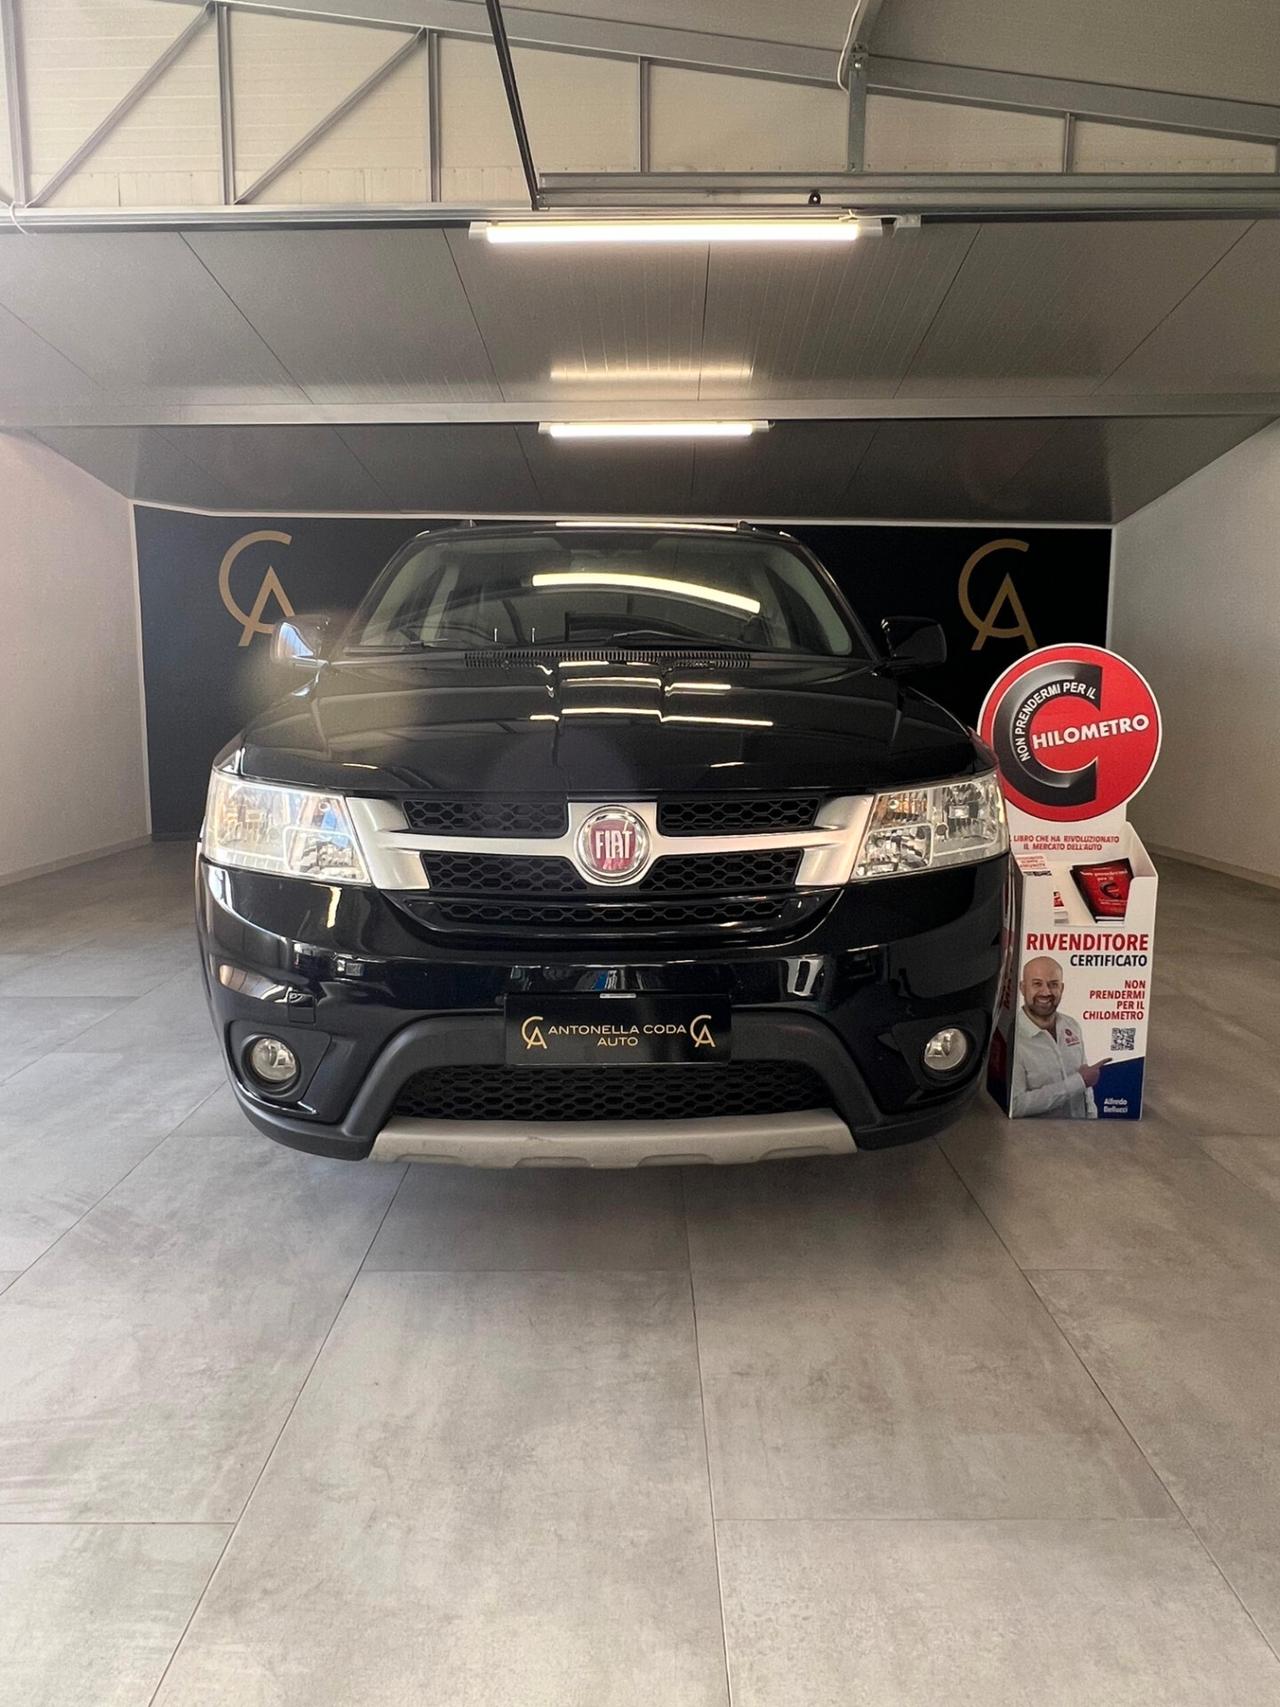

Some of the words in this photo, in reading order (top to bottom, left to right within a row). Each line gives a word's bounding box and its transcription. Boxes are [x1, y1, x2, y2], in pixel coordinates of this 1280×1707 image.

[1063, 682, 1085, 694] PER
[1086, 686, 1097, 700] IL
[1015, 683, 1061, 735] PRENDERMI
[1015, 738, 1031, 762] NON
[595, 830, 633, 859] FIAT
[1051, 835, 1061, 843] HA
[1063, 835, 1120, 844] RIVOLUZIONATO
[1066, 843, 1103, 851] DELL'AUTO
[1026, 933, 1149, 951] RIVENDITORE
[1070, 954, 1148, 967] CERTIFICATO
[1124, 980, 1146, 989] NON
[1089, 990, 1145, 999] PRENDERMI
[1116, 1001, 1134, 1009] PER
[1136, 1001, 1145, 1009] IL
[1082, 1011, 1144, 1020] CHILOMETRO
[548, 1024, 640, 1035] ANTONELLA
[642, 1024, 688, 1035] CODA
[597, 1036, 639, 1047] AUTO
